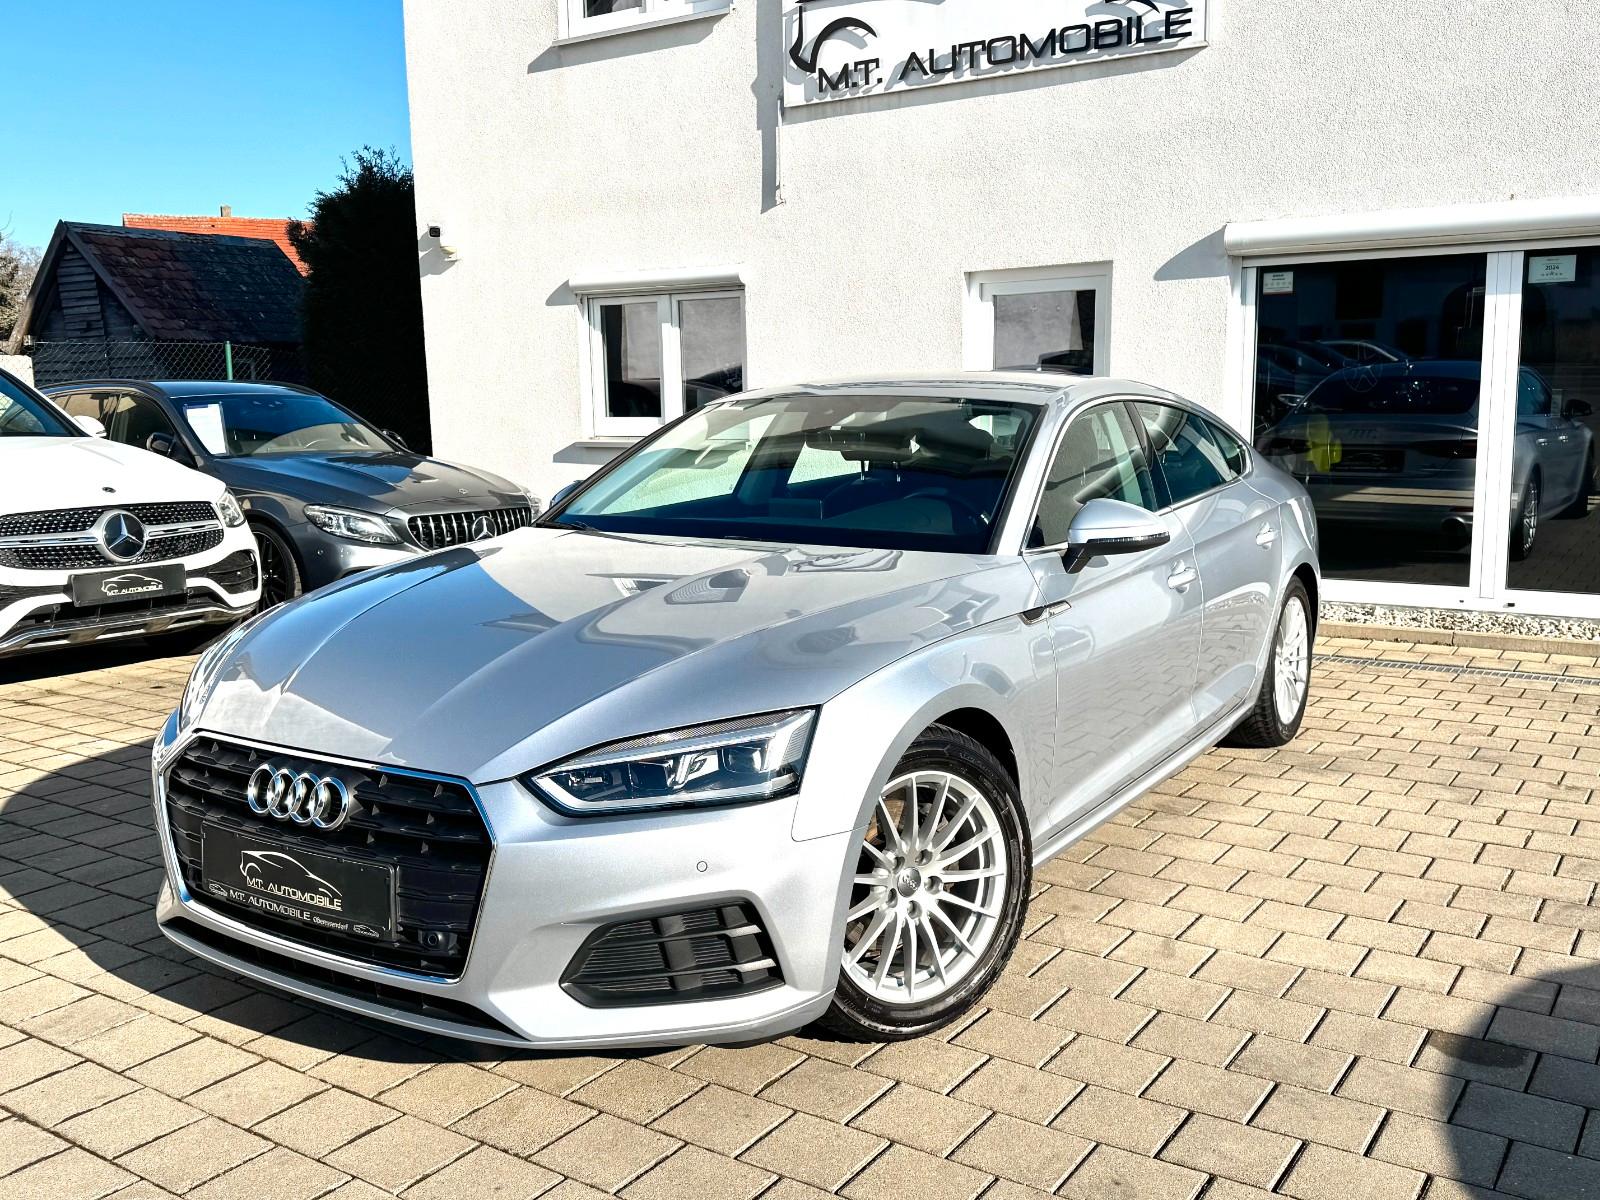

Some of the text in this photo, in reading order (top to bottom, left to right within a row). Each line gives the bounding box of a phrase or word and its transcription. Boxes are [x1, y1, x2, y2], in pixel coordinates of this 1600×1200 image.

[818, 8, 1193, 93] M.T. AUTOMOBILE
[121, 584, 164, 595] AUTOMOBILE
[229, 889, 246, 902] M.T.
[248, 896, 311, 920] AUTOMOBILE
[246, 876, 264, 891] M.T.
[267, 882, 343, 912] AUTOMOBILE
